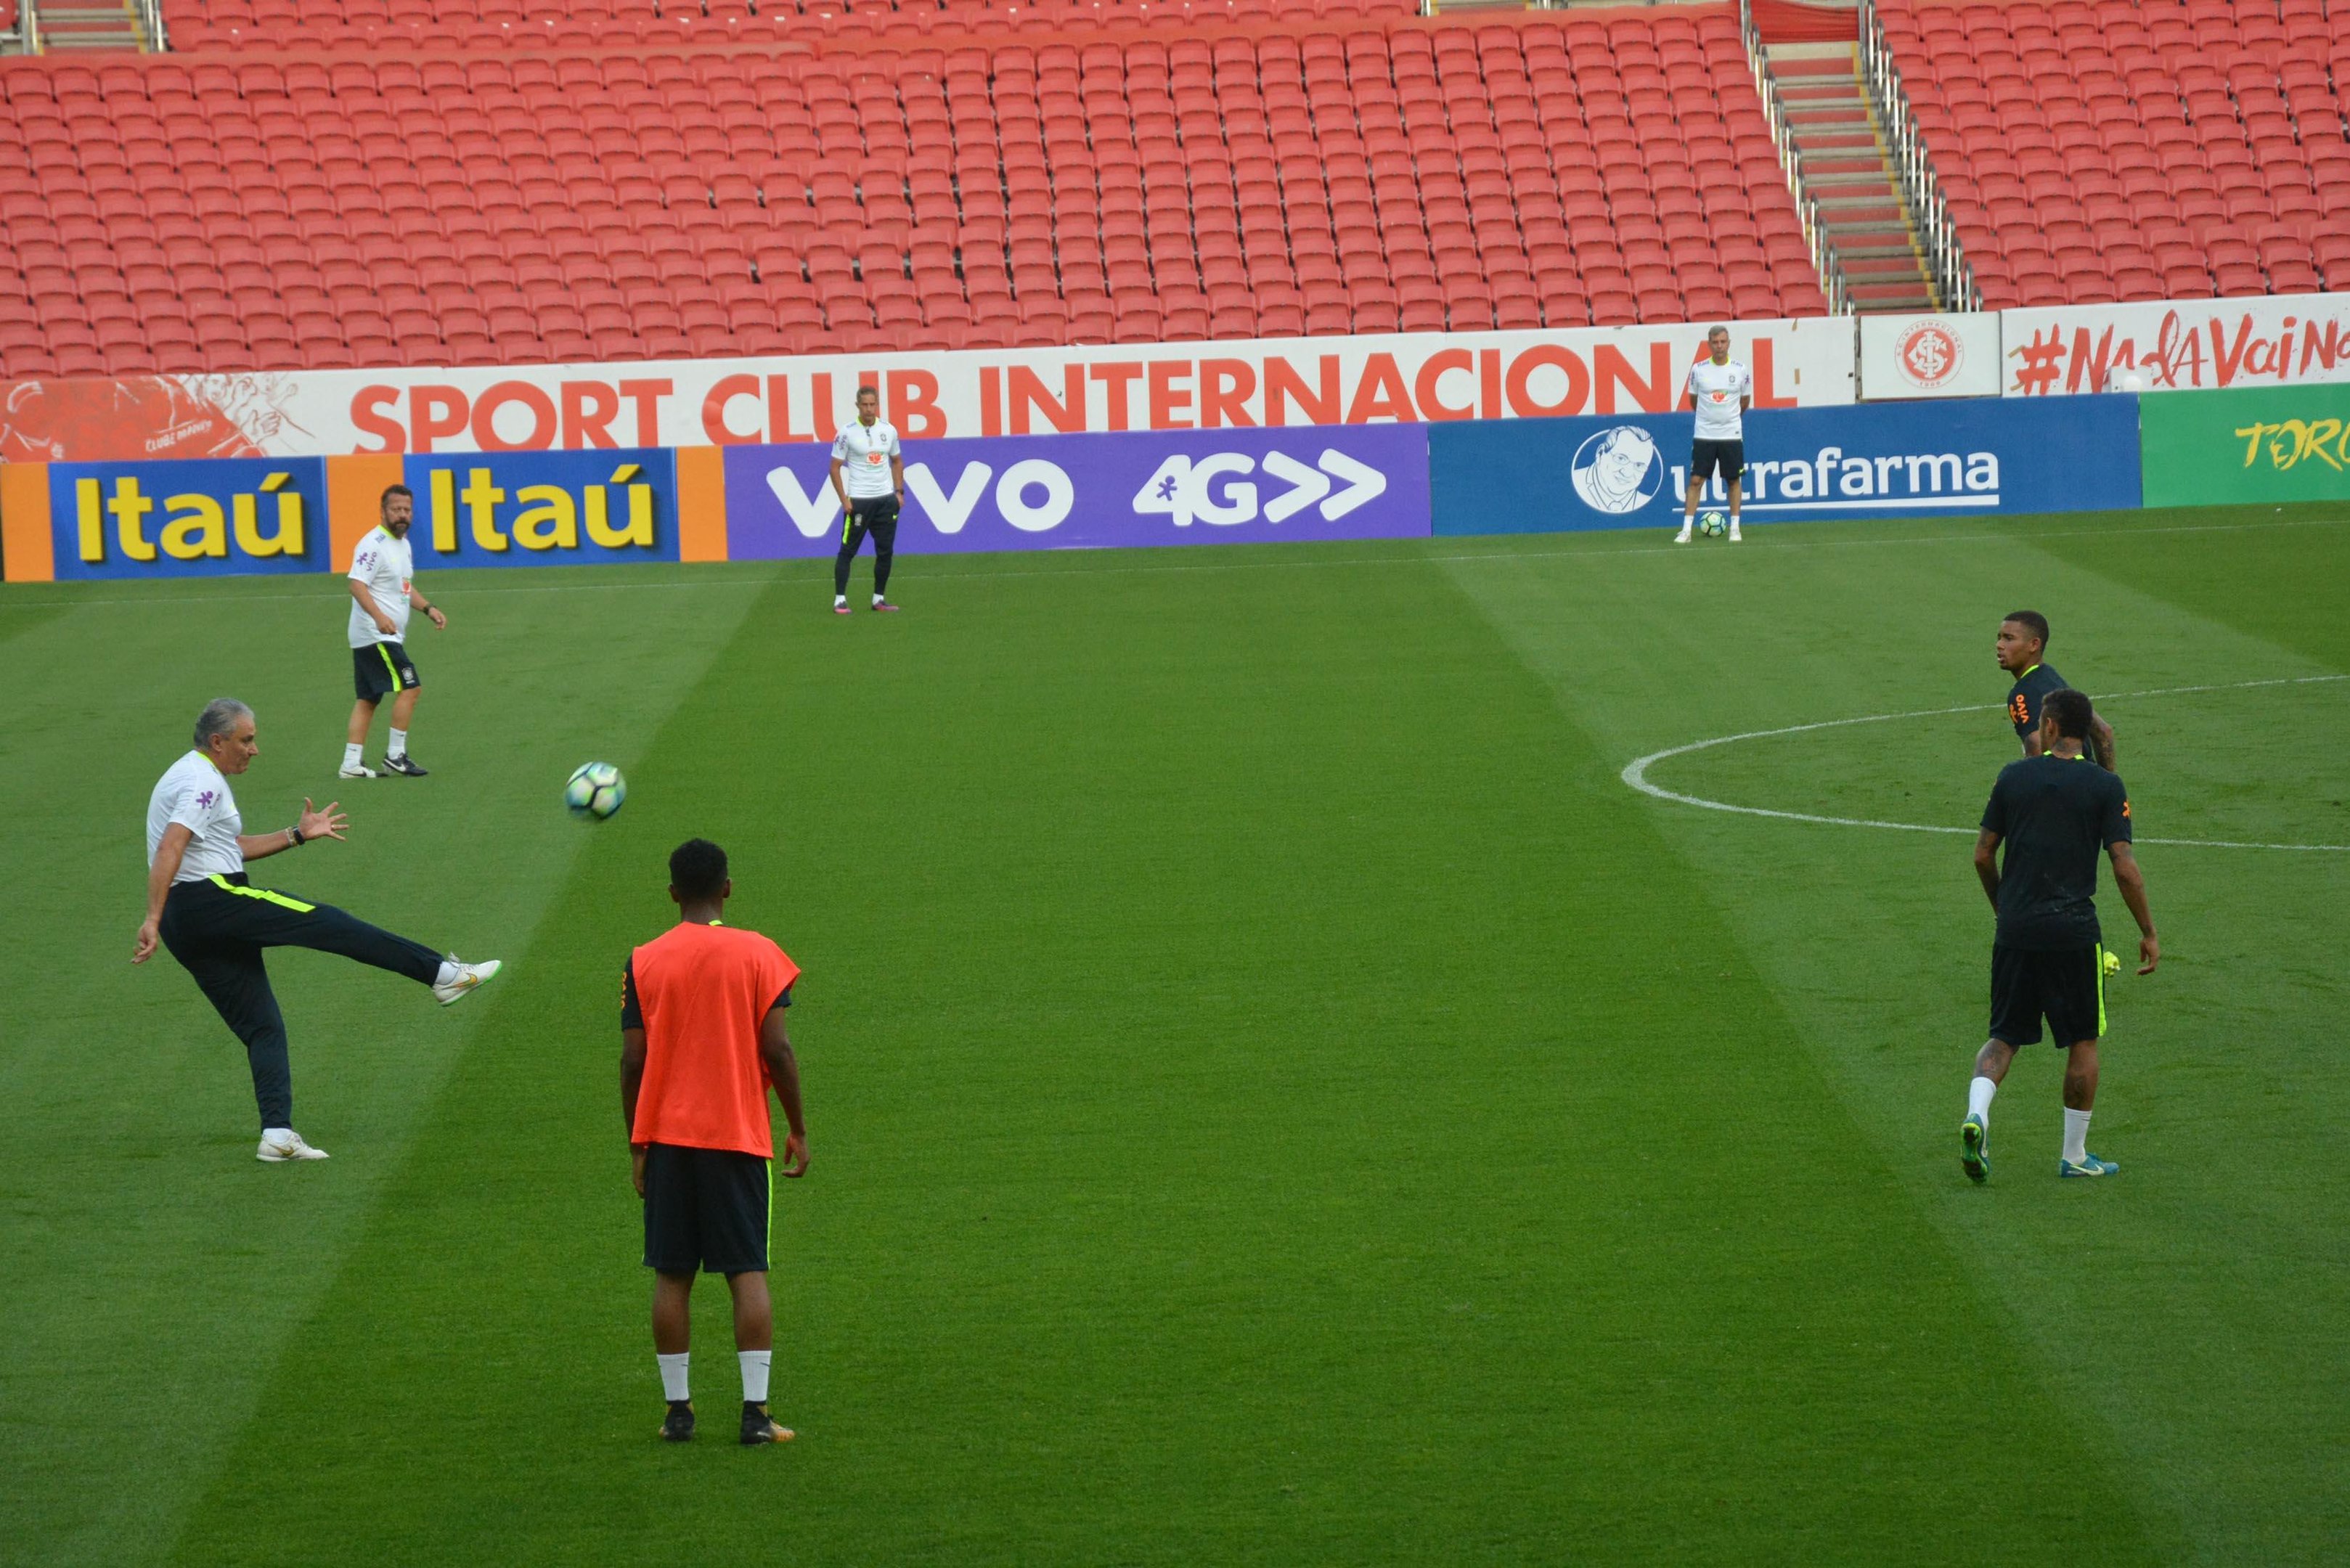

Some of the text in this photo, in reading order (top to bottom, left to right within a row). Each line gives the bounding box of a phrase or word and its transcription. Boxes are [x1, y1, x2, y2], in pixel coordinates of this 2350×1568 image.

[350, 378, 674, 455] SPORT
[701, 368, 947, 446] CLUB
[76, 473, 304, 561] Itaú
[430, 465, 653, 552] Itaú
[366, 551, 378, 572] vivo
